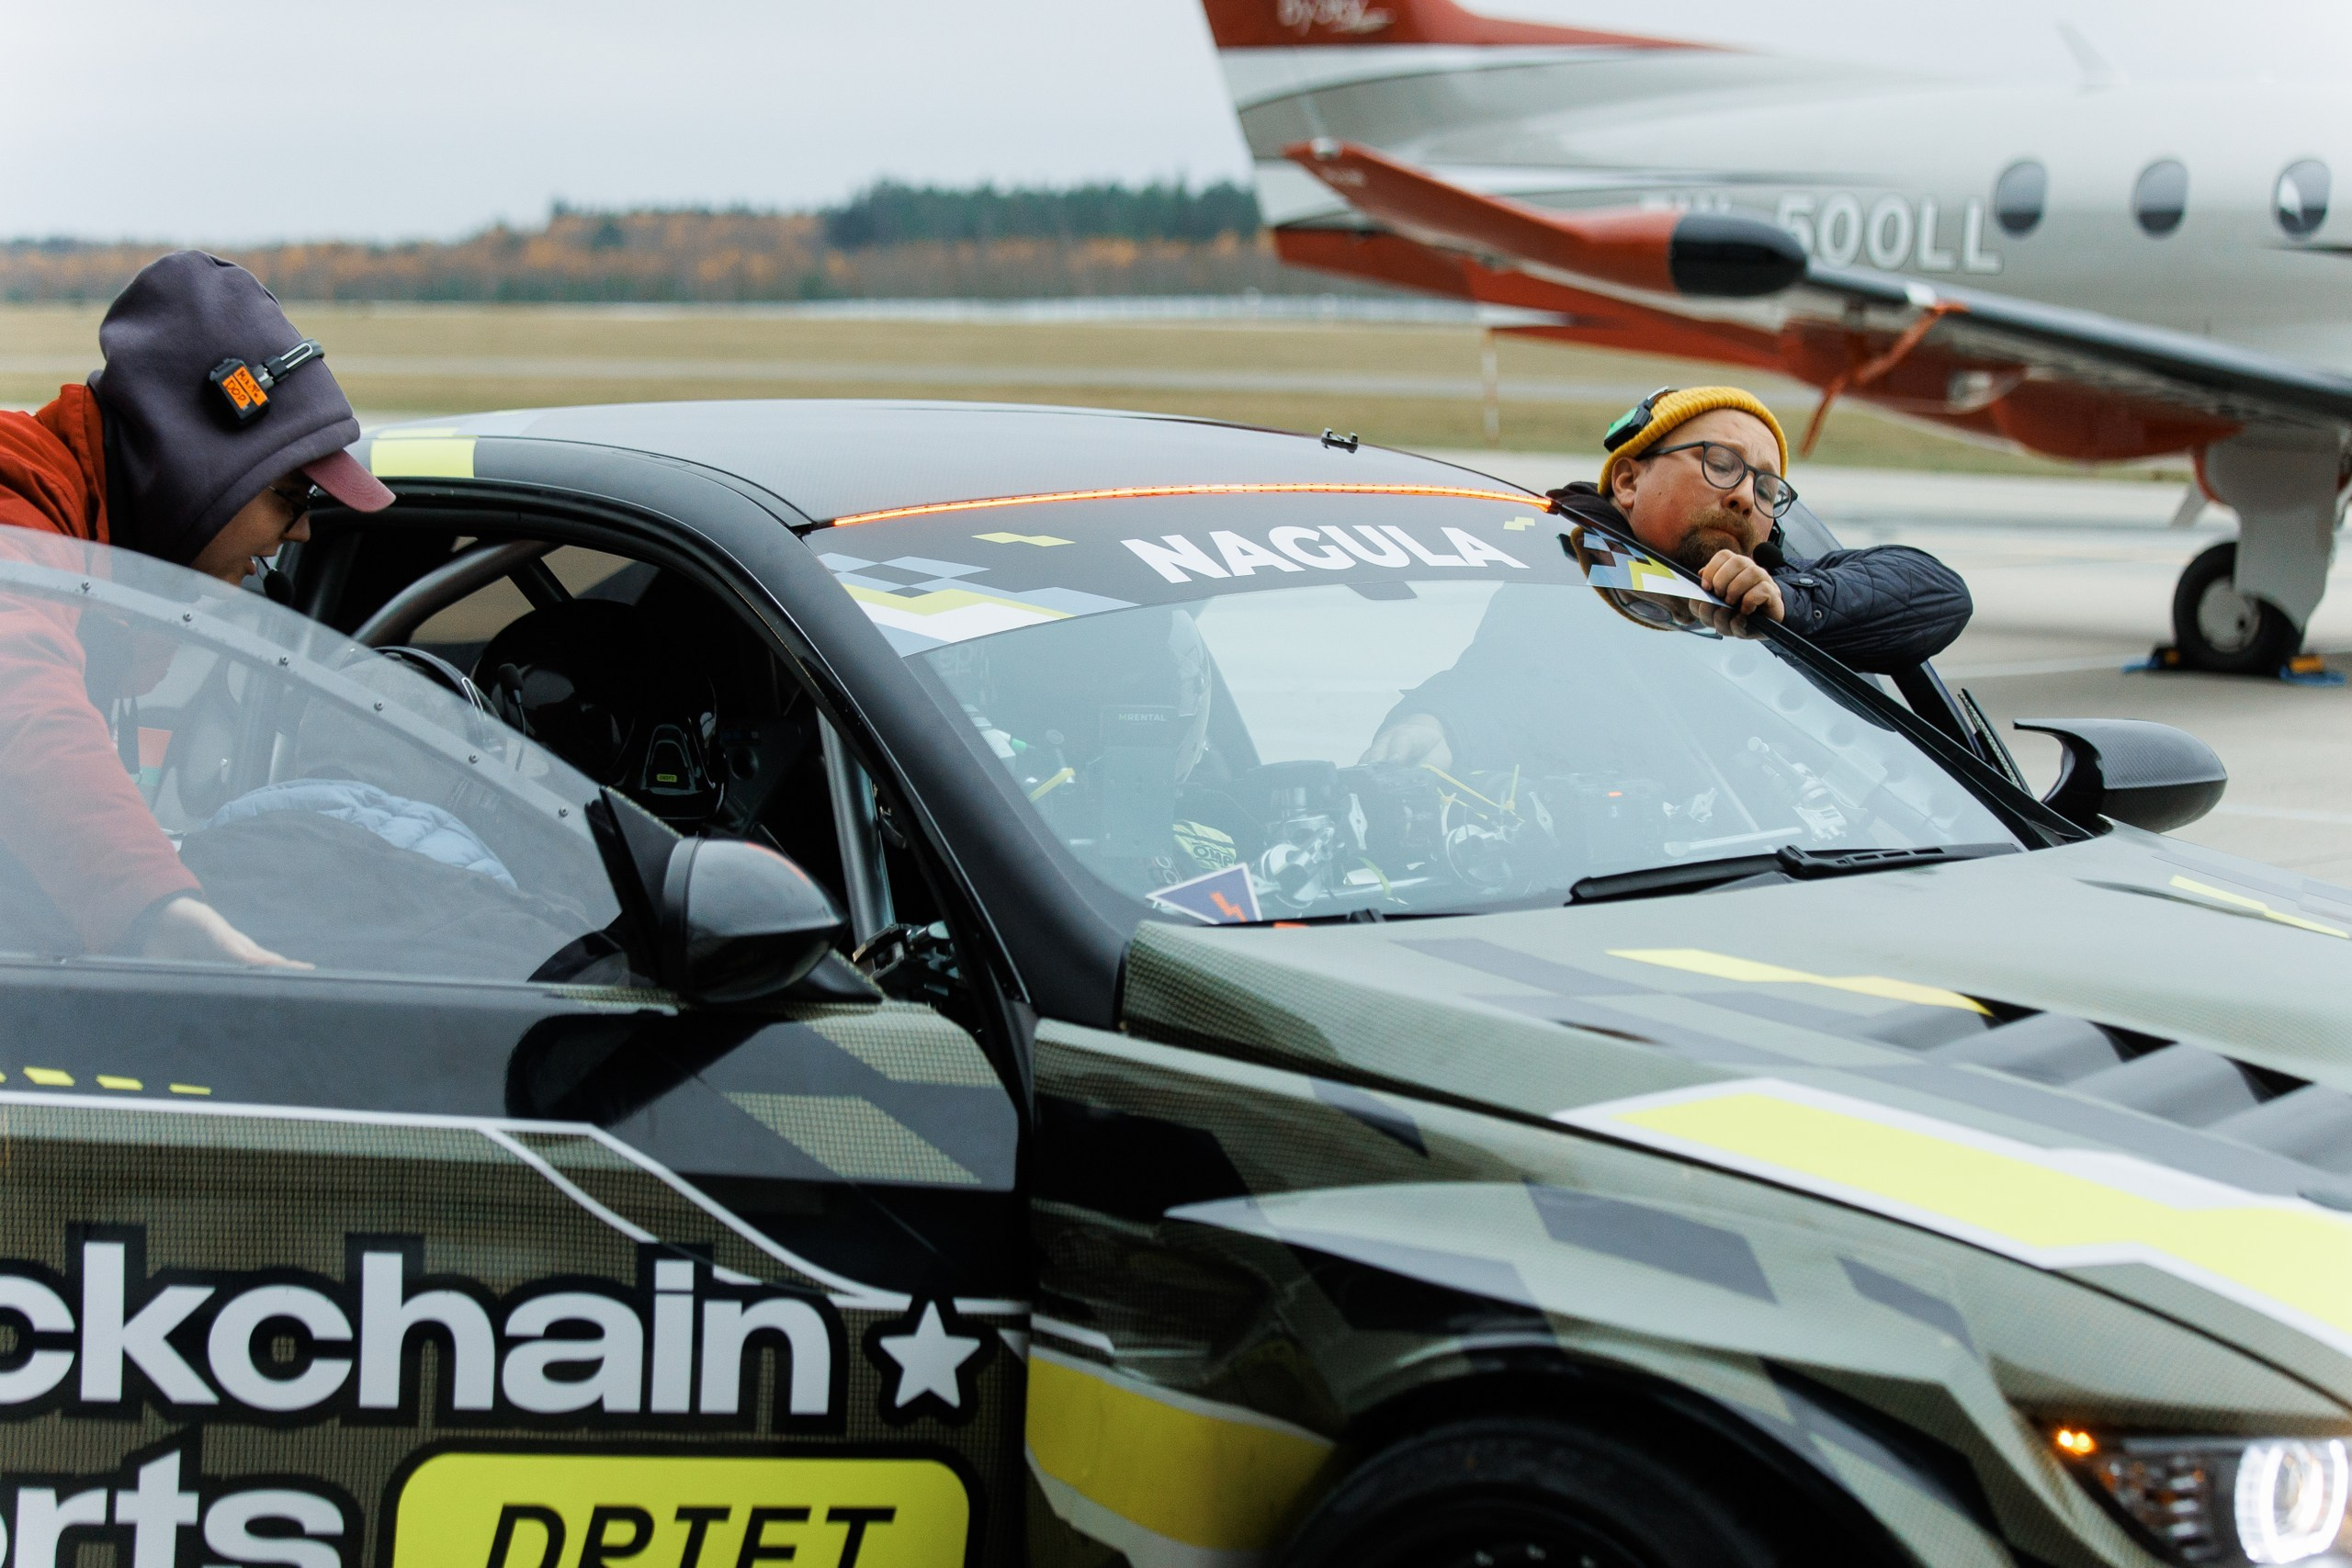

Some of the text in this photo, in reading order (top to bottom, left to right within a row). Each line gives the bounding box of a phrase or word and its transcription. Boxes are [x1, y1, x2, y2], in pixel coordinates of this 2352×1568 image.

[225, 378, 246, 401] DOP
[1120, 525, 1531, 584] NAGULA
[1193, 844, 1234, 868] OMP
[0, 1449, 345, 1568] rts
[487, 1504, 897, 1568] DRIFT
